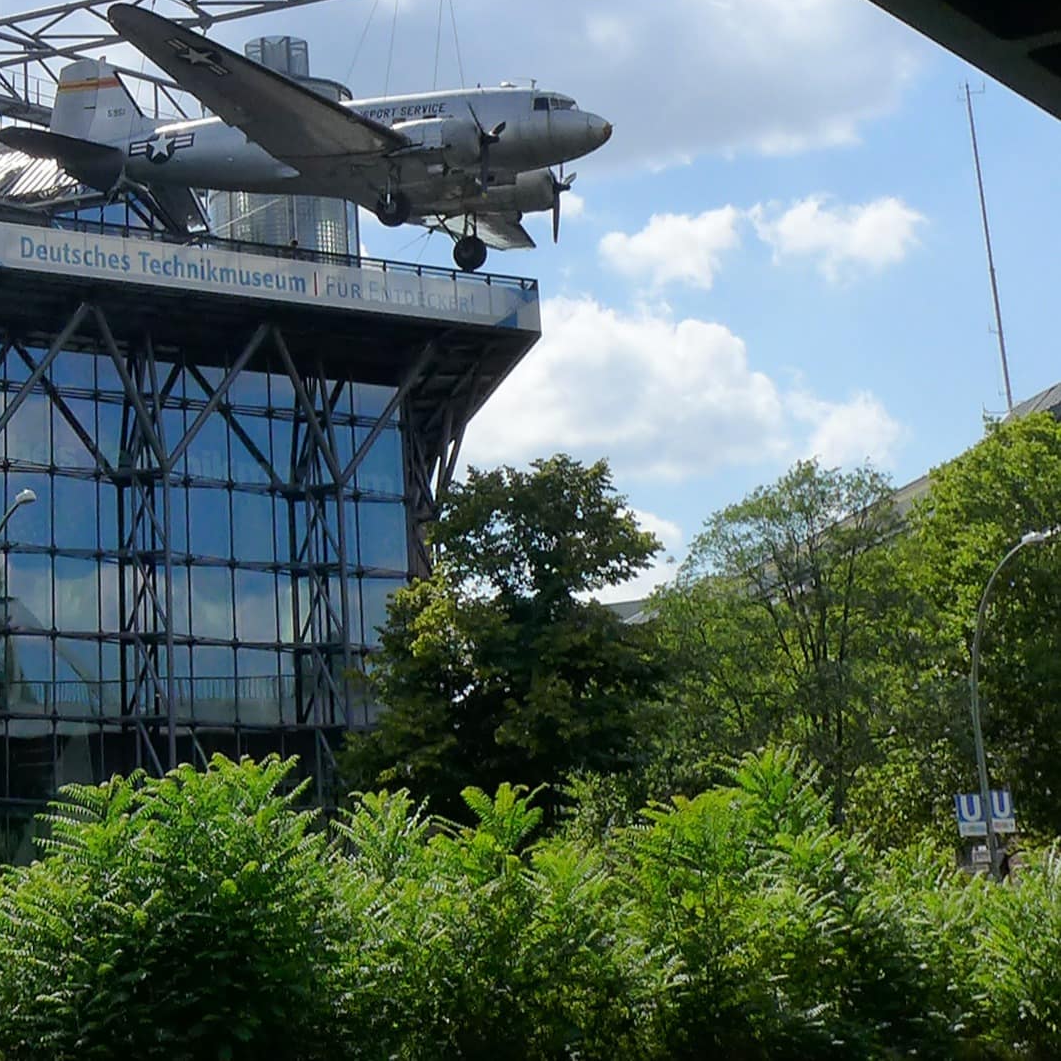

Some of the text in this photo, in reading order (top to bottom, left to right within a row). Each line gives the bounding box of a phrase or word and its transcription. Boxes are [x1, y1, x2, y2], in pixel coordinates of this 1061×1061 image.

[400, 102, 447, 116] SERVICE
[20, 236, 131, 273] Deutsches
[138, 250, 307, 294] Technikmuseum
[325, 273, 361, 299] FÜR
[960, 794, 982, 821] U
[992, 791, 1011, 818] U
